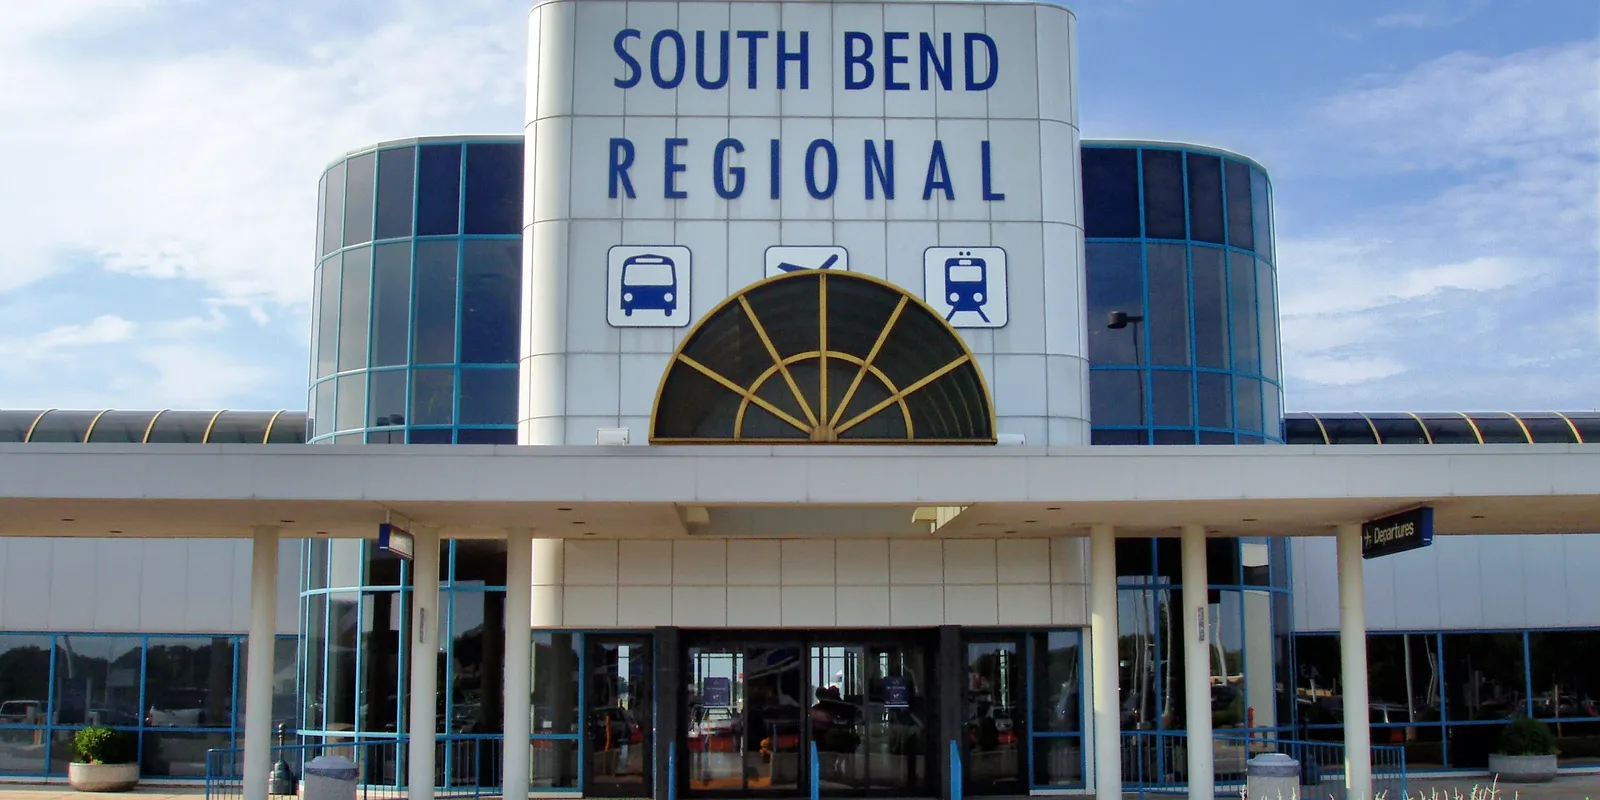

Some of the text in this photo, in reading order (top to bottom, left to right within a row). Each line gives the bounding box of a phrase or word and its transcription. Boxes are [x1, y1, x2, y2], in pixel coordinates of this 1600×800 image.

[613, 28, 1000, 91] SOUTH BEND
[608, 137, 1006, 201] REGIONAL
[1374, 522, 1414, 546] Departures
